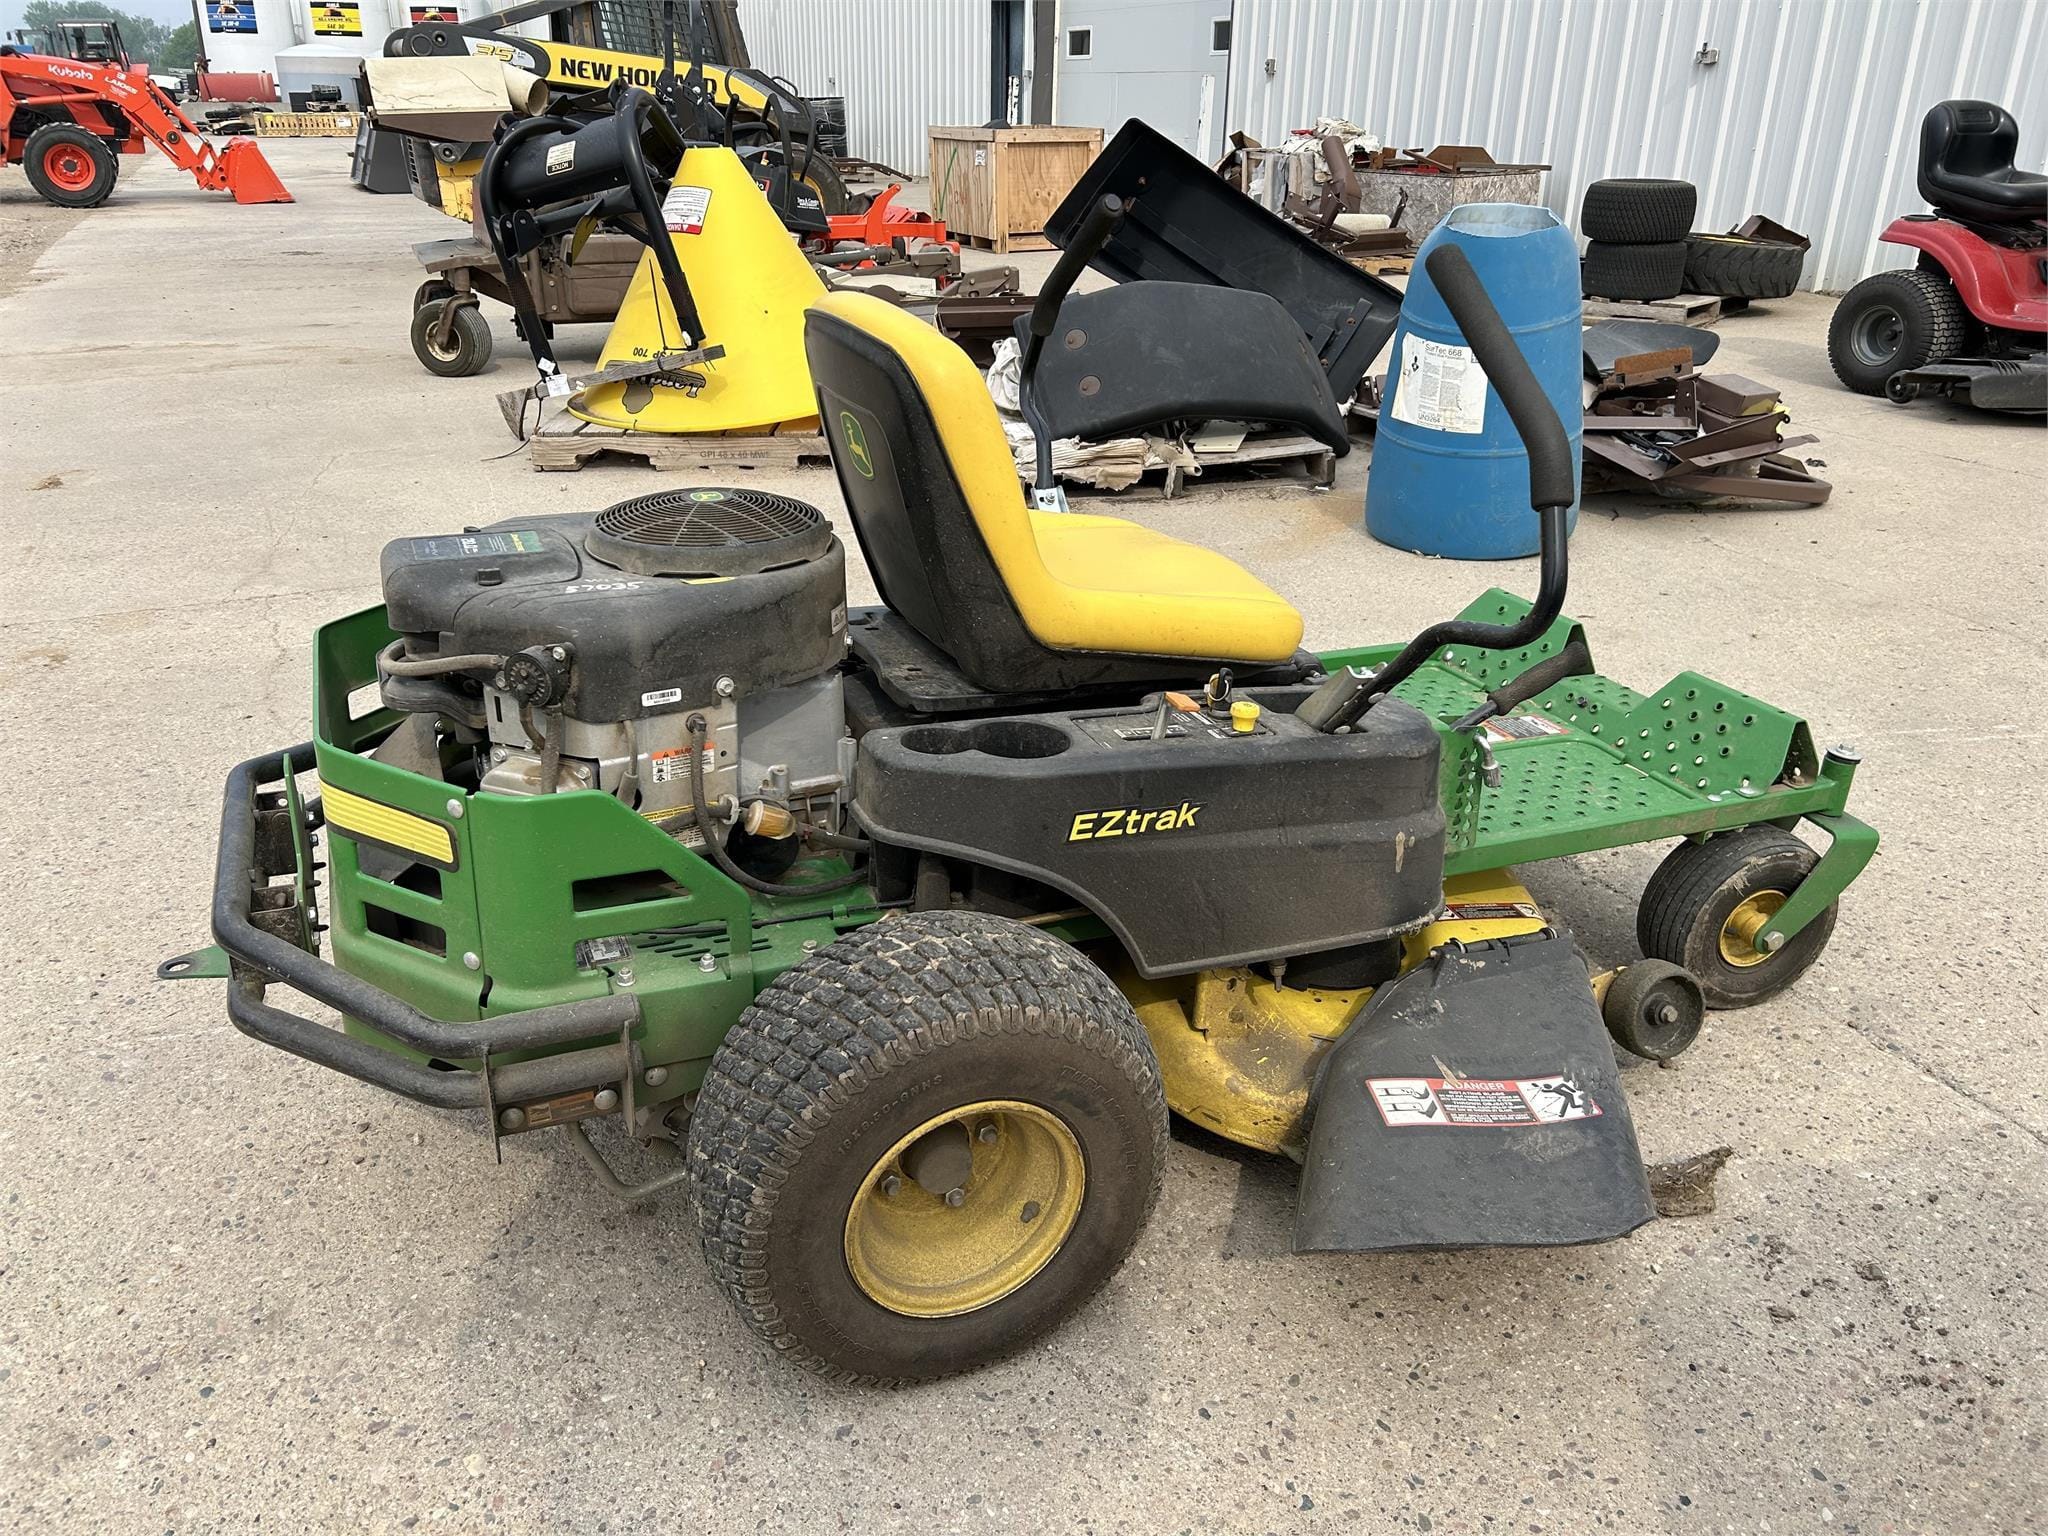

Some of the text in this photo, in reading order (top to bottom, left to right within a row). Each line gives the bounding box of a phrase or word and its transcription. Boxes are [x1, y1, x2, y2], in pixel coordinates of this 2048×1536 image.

[47, 64, 94, 81] Kubota
[560, 57, 612, 82] NEW
[632, 347, 648, 357] 700
[1425, 343, 1447, 355] SurTec
[1448, 348, 1463, 357] 668
[565, 581, 645, 594] 57035
[1069, 802, 1201, 841] EZtrak
[1455, 1081, 1506, 1090] DANGER
